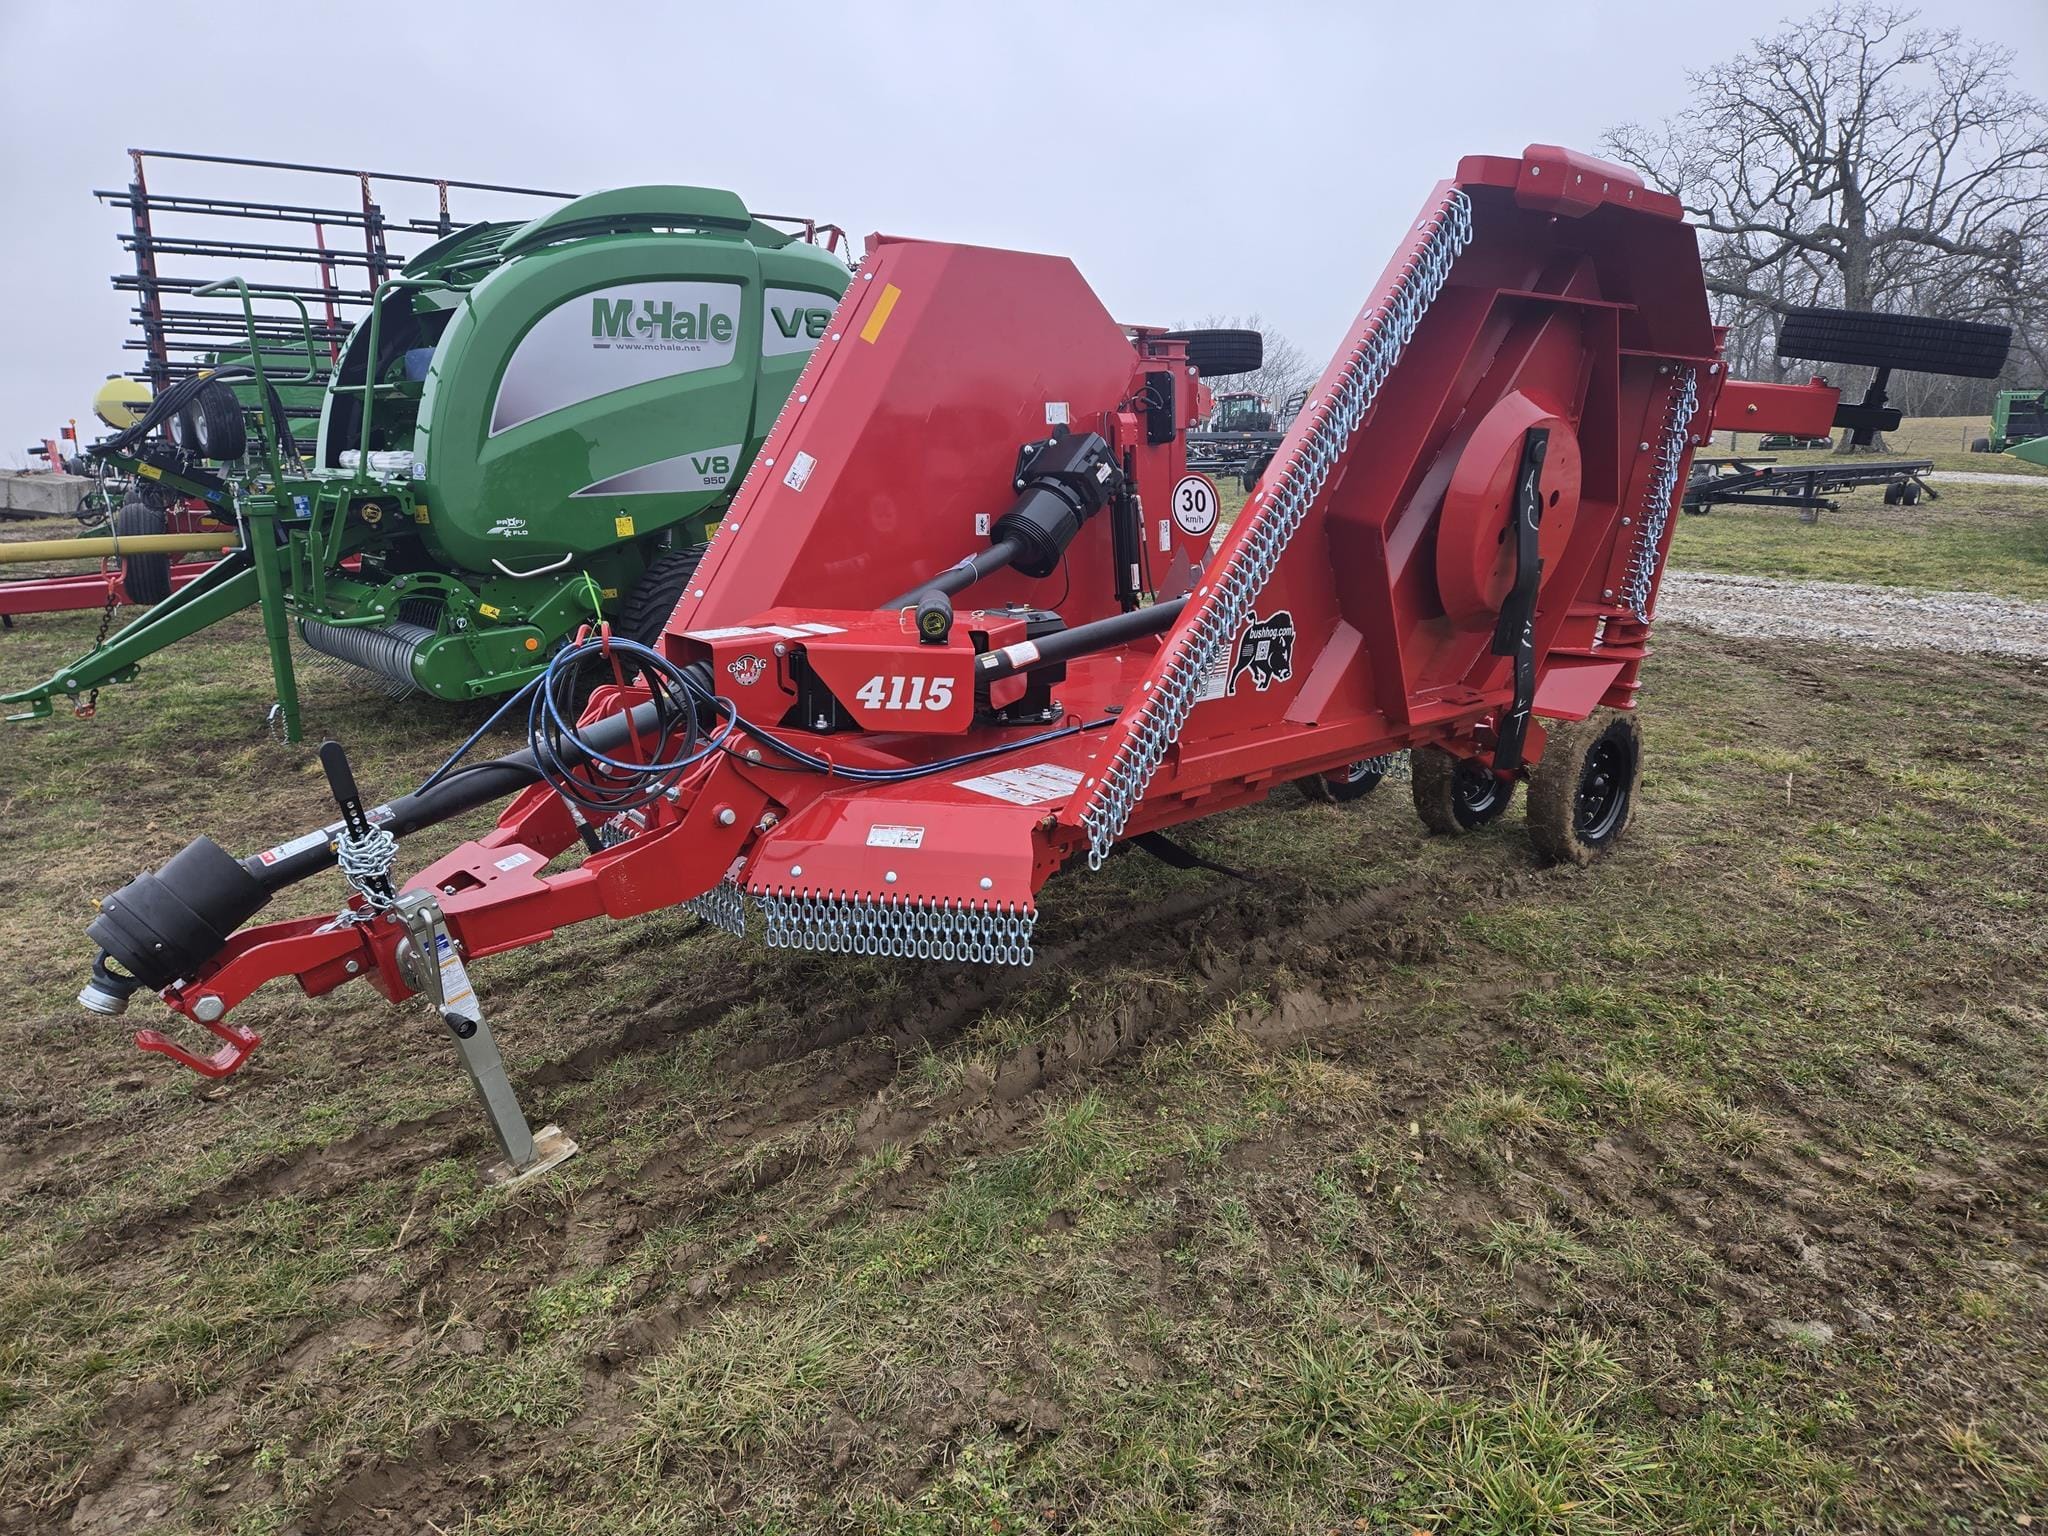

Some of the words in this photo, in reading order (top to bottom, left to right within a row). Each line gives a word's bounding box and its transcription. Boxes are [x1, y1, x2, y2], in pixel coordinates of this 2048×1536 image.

[591, 297, 733, 341] McHale
[771, 306, 832, 339] V8
[616, 343, 702, 352] www.mchale.net
[691, 456, 730, 475] V8
[703, 476, 726, 485] 950
[1182, 488, 1206, 513] 30
[1185, 514, 1204, 524] km/h
[1249, 626, 1292, 640] bushhog.com
[855, 675, 955, 711] 4115
